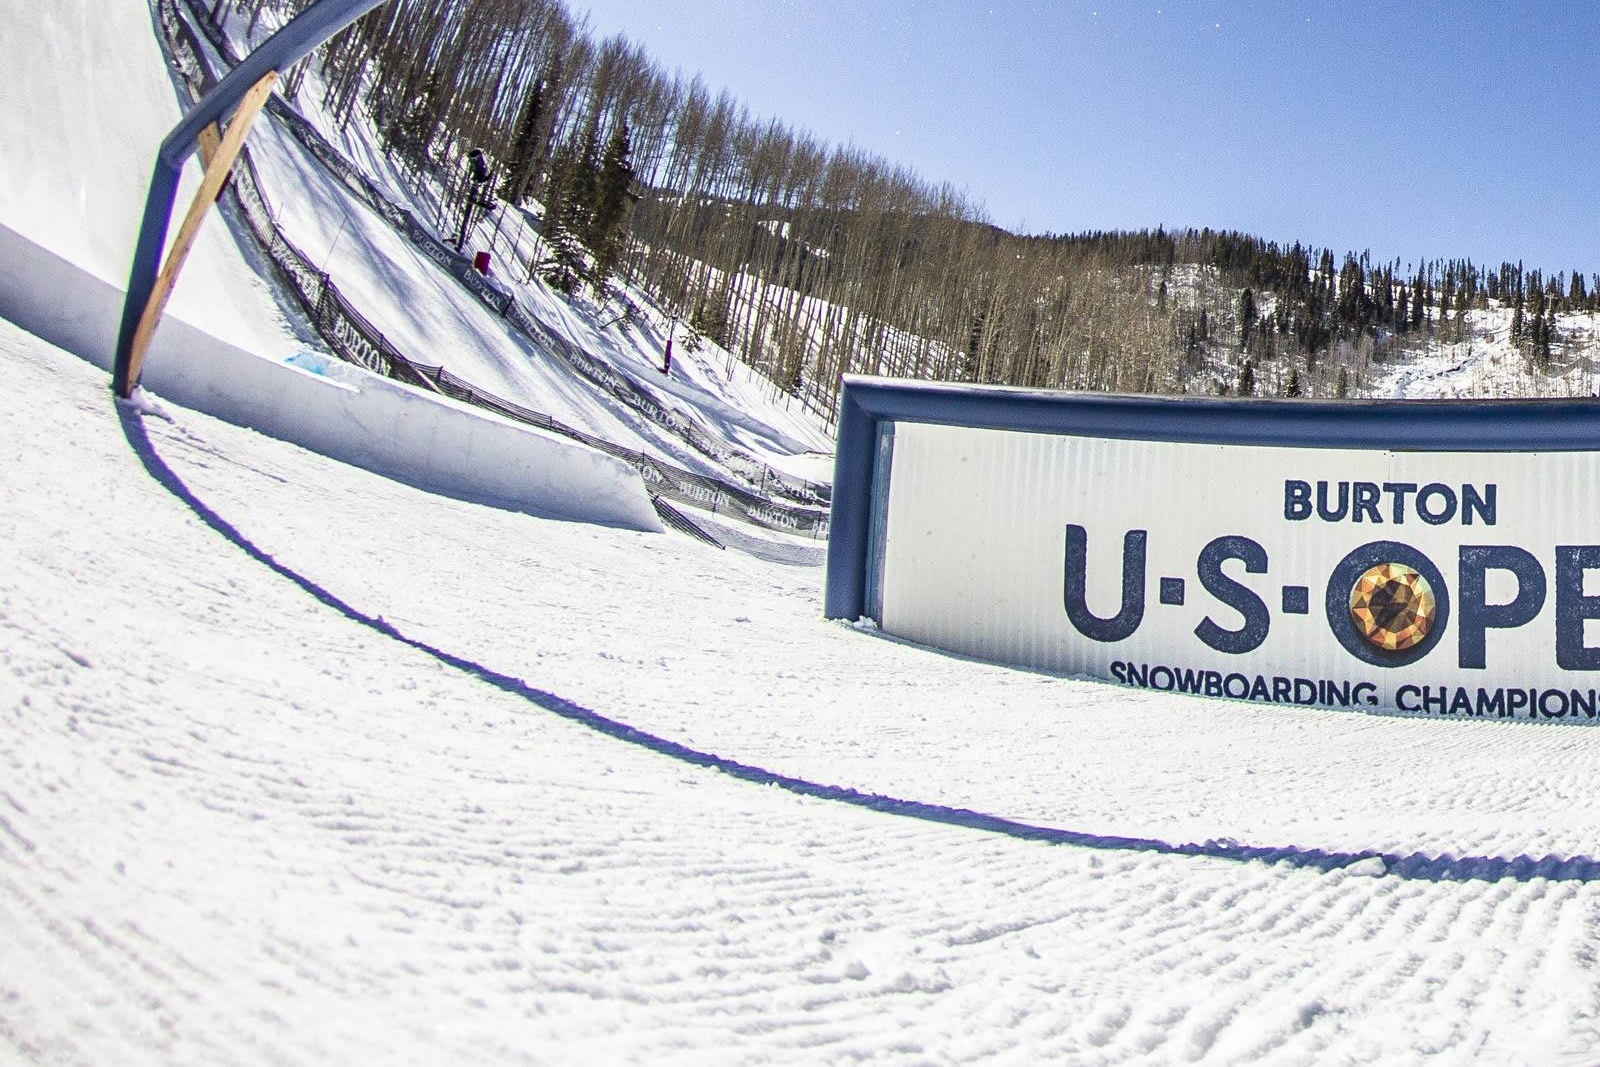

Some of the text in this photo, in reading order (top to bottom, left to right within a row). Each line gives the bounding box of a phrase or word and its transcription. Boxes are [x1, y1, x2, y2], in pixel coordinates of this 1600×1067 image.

[334, 312, 392, 377] BURTON
[748, 506, 798, 531] BURTON
[1284, 479, 1498, 526] BURTON
[1110, 660, 1379, 706] SNOWBOARDING
